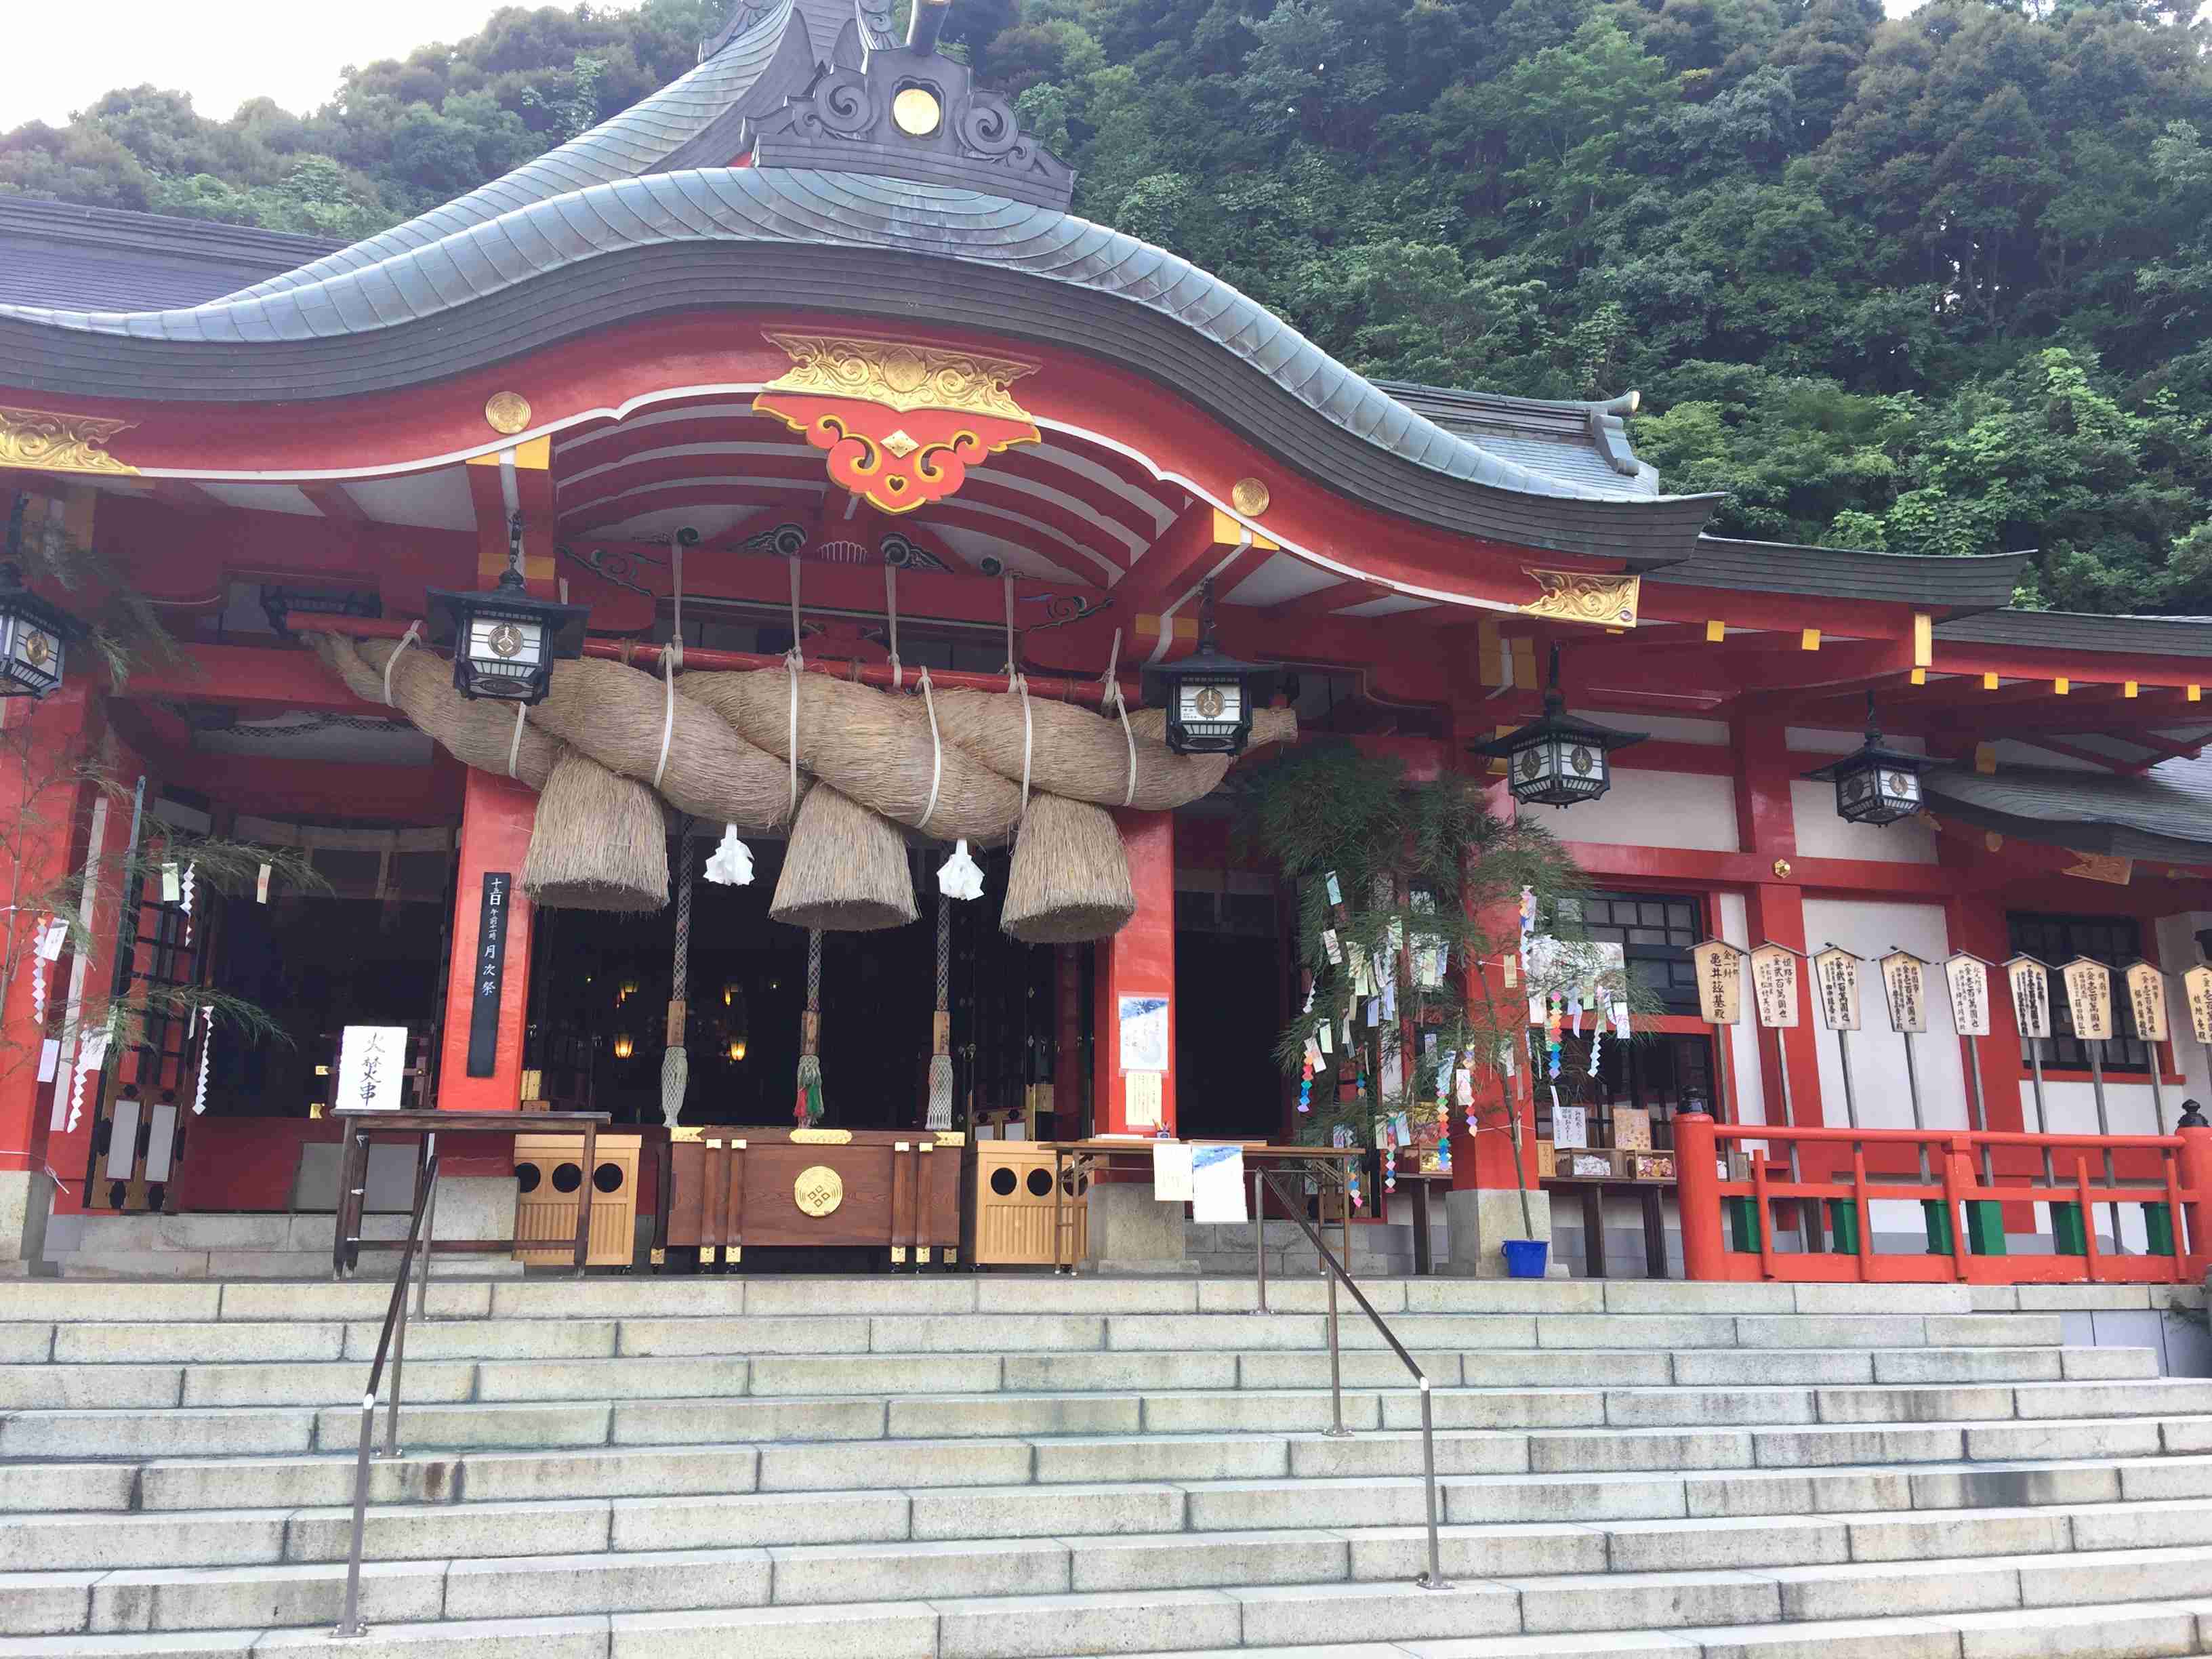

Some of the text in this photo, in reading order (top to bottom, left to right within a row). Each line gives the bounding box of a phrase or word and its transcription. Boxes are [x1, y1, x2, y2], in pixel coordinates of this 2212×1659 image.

[489, 878, 503, 905] 十五日
[482, 945, 496, 996] 月次祭
[1845, 961, 1854, 987] 山口市
